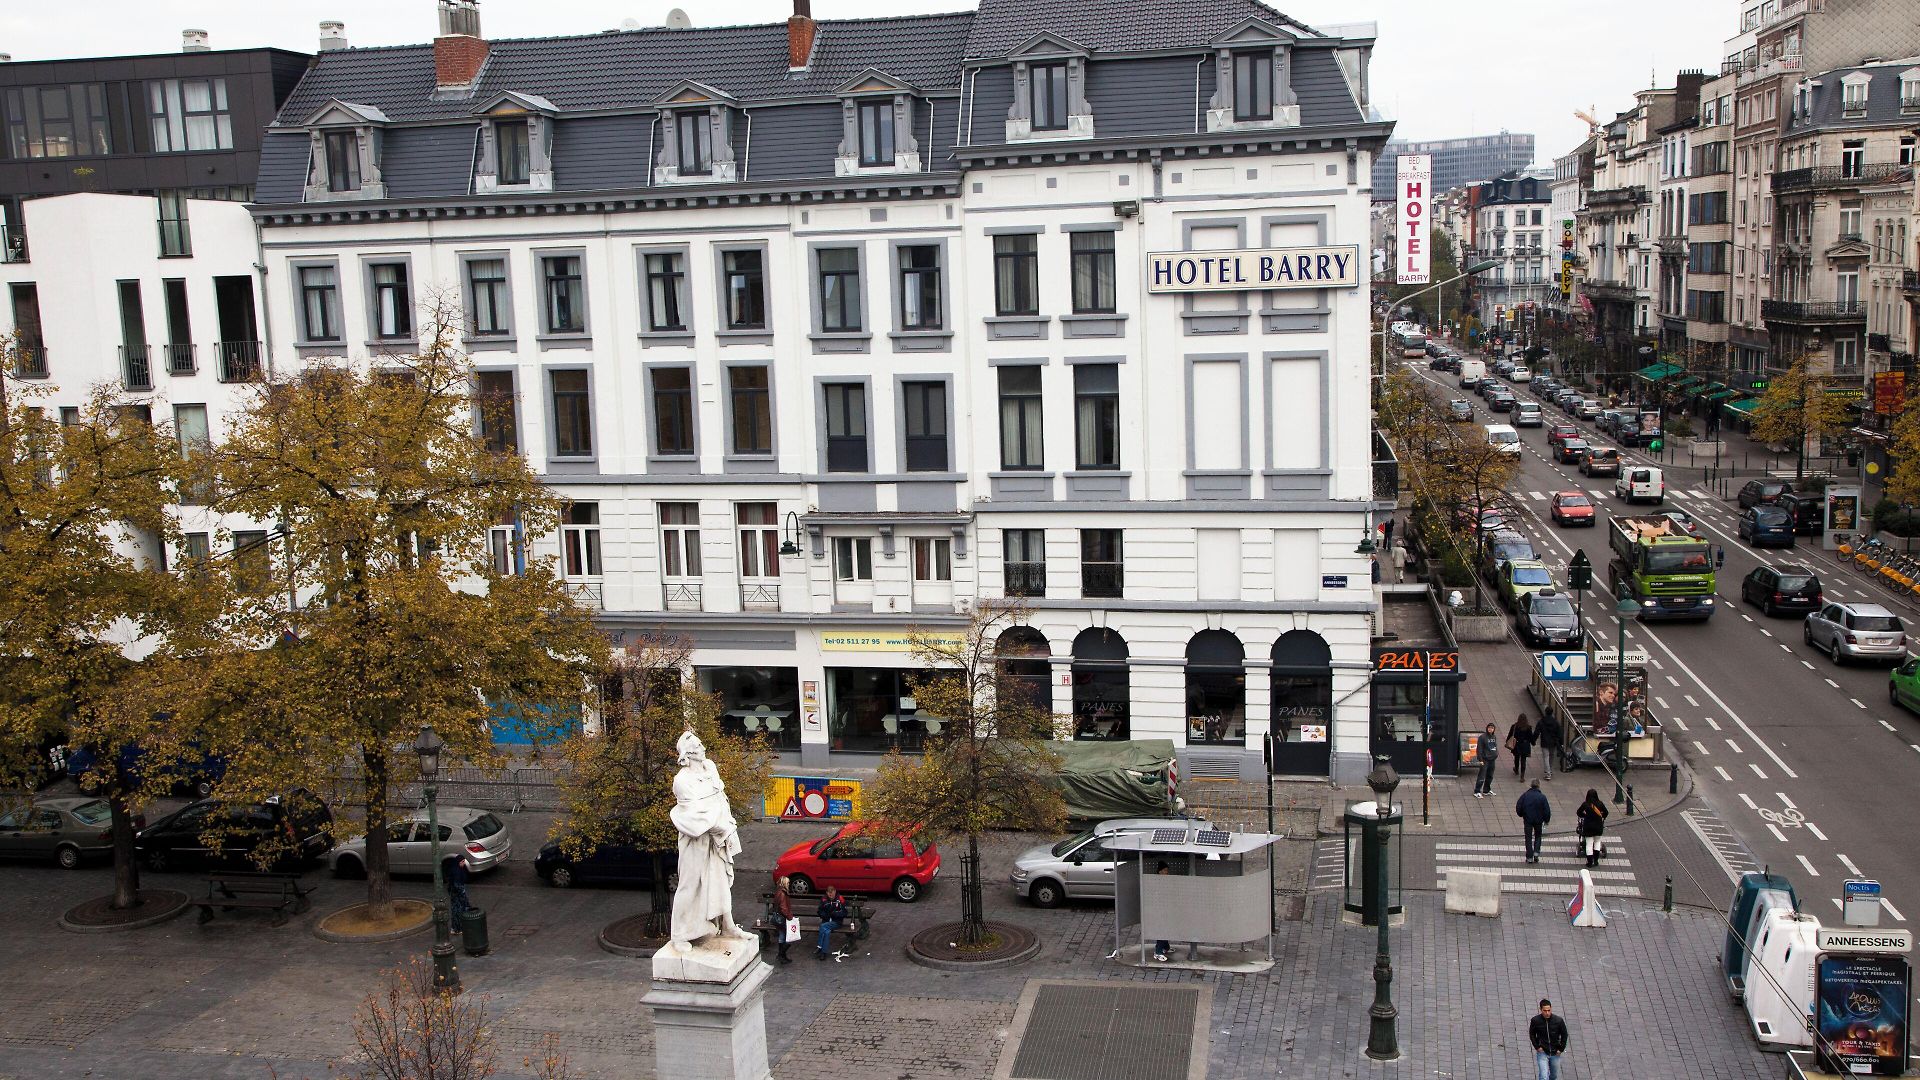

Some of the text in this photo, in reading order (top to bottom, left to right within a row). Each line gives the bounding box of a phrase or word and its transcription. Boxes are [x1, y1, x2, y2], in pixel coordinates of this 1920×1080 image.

[1408, 157, 1420, 165] BED
[1398, 172, 1431, 180] BREAKFAST
[1406, 182, 1422, 273] HOTEL
[1154, 253, 1350, 286] HOTEL BARRY
[1398, 274, 1429, 282] BARRY
[1378, 651, 1460, 669] PANES
[1080, 702, 1124, 711] PANES
[1279, 706, 1325, 717] PANES
[1826, 936, 1905, 947] ANNEESSENS
